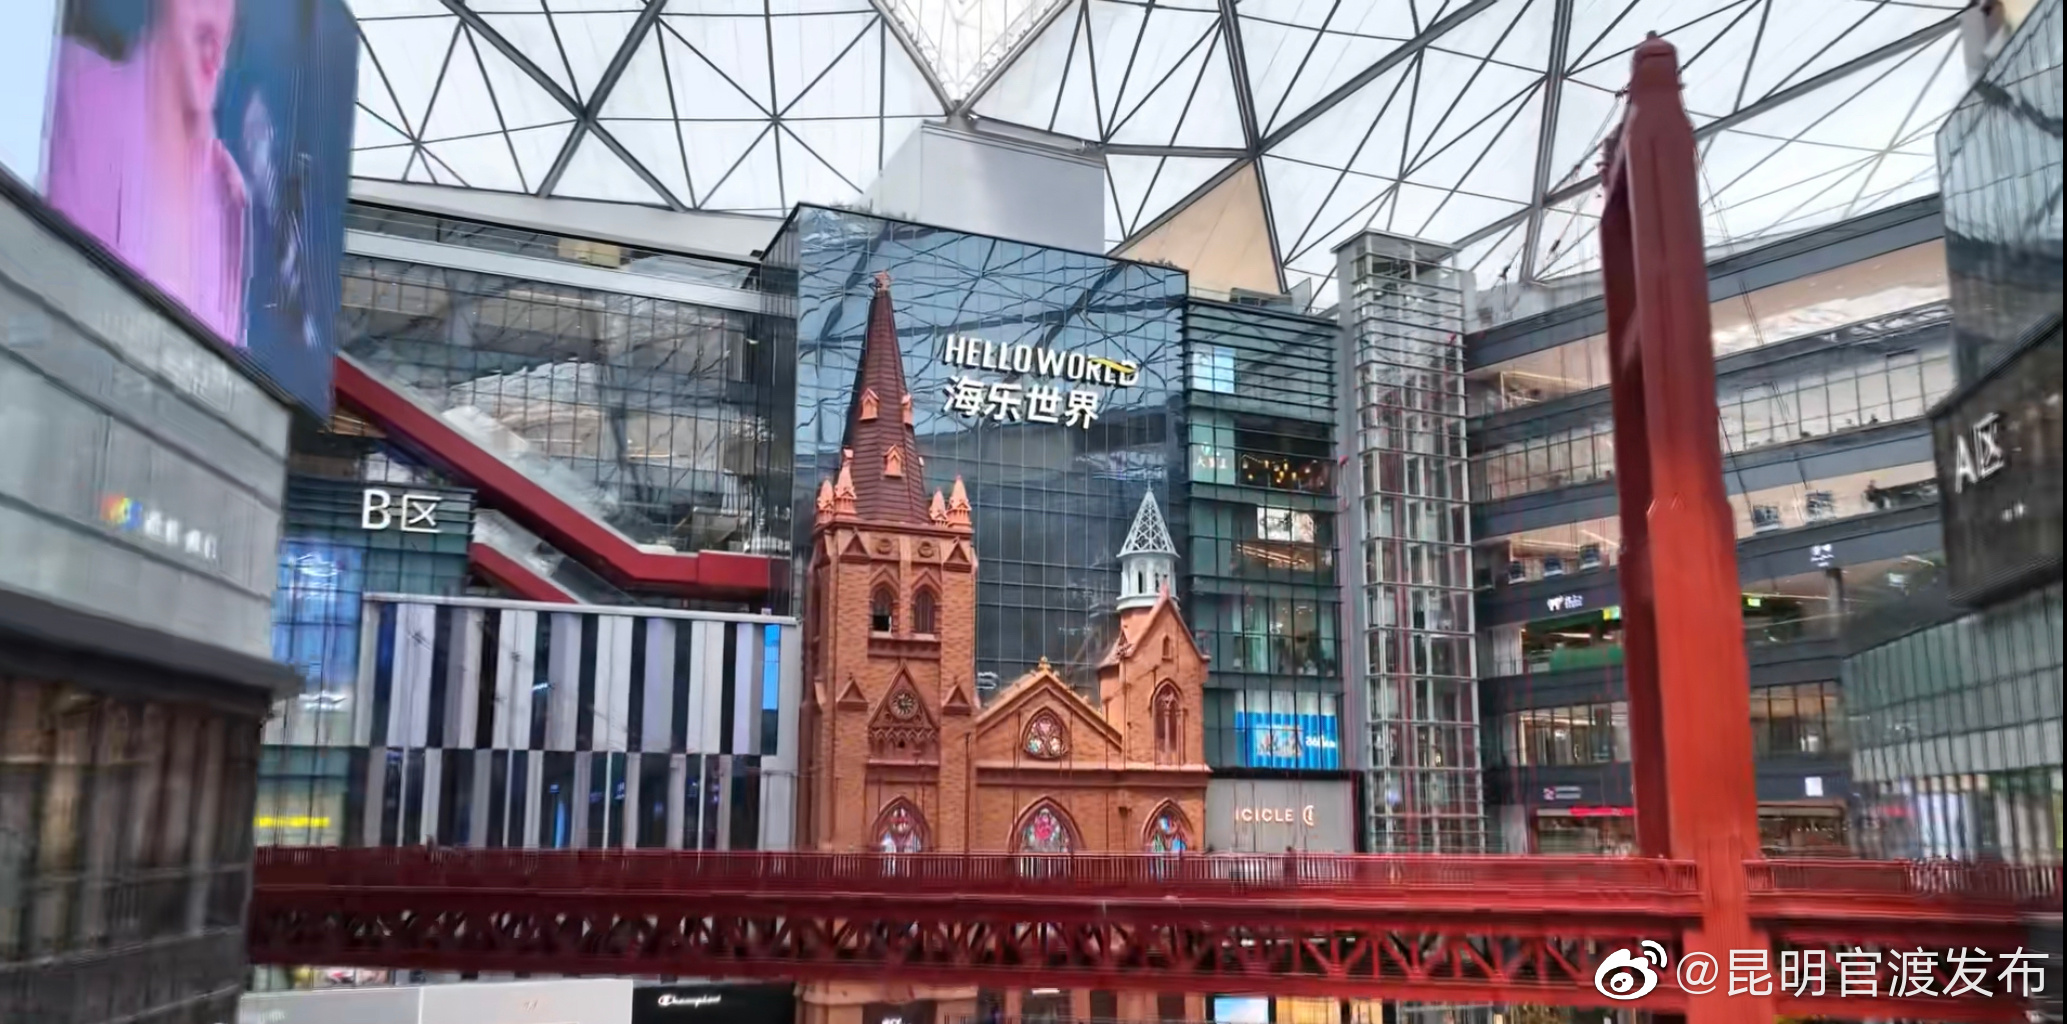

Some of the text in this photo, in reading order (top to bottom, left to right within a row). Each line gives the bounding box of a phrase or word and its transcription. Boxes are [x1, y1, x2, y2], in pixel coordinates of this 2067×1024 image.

[943, 375, 1099, 430] 海乐世界
[1955, 412, 2004, 494] A区
[362, 488, 442, 533] B区
[1235, 807, 1294, 822] ICICLE
